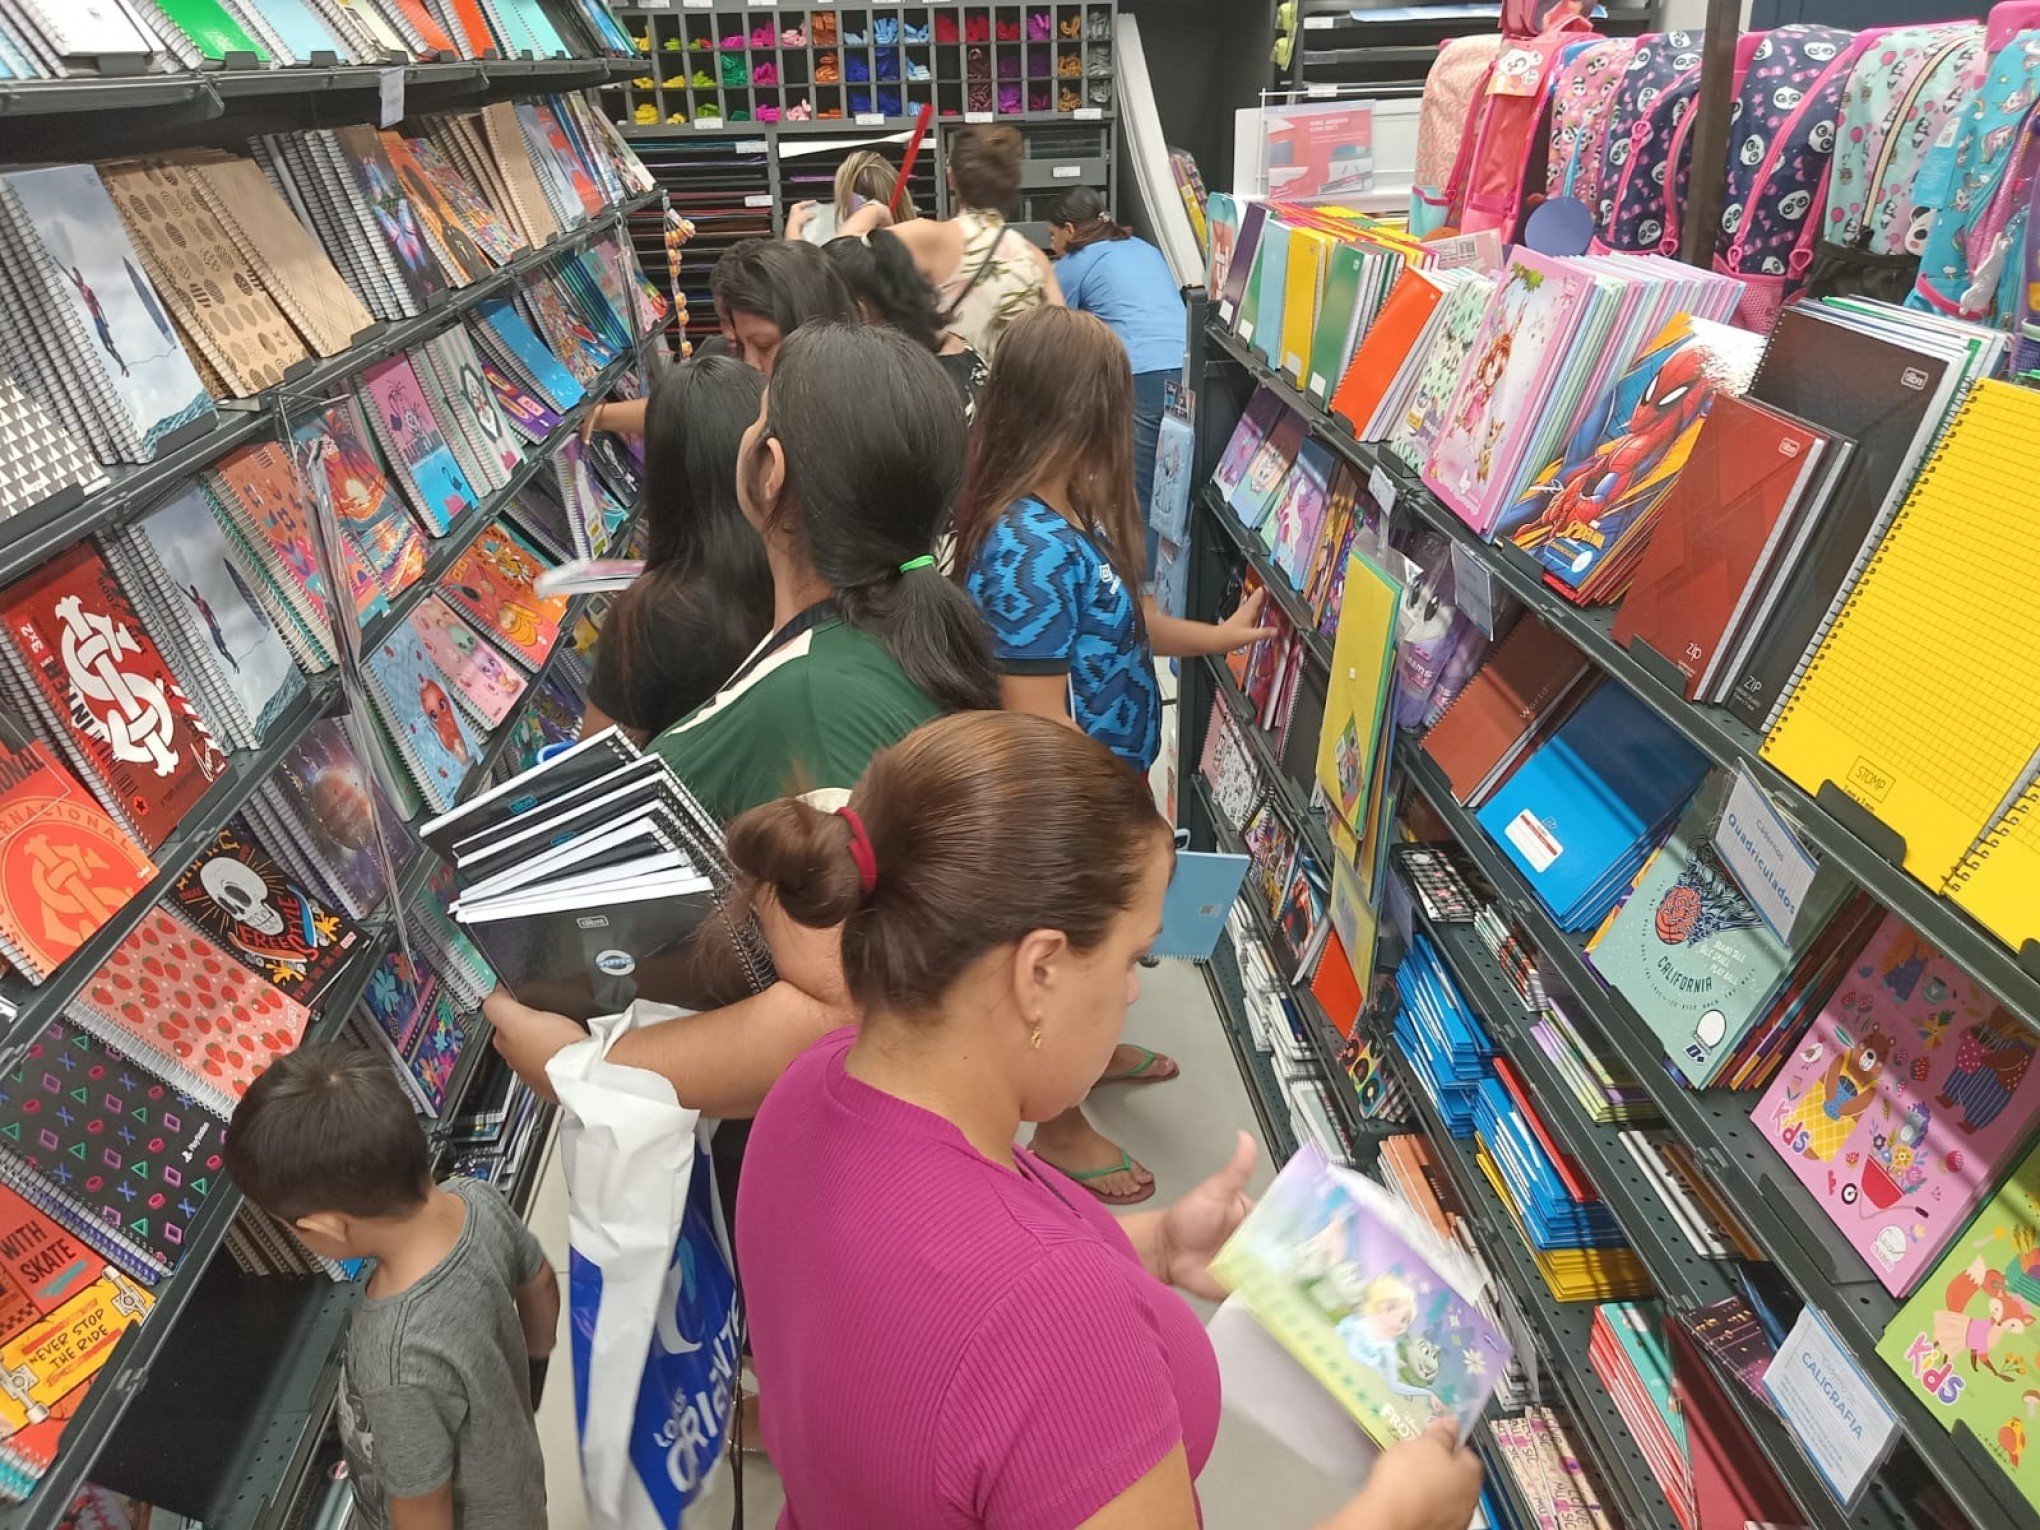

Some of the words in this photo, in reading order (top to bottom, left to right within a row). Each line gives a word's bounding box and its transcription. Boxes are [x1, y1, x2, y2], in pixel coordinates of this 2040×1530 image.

[1855, 766, 1886, 790] STOMP
[1728, 812, 1796, 915] Quadriculados
[1657, 956, 1713, 992] CALIFORNIA
[1771, 1101, 1811, 1153] Kids
[0, 1220, 47, 1261] WITH
[20, 1238, 77, 1284] SKATE
[28, 1332, 69, 1364] NEVER
[72, 1308, 104, 1336] STOP
[50, 1347, 76, 1369] THE
[77, 1325, 108, 1351] RIDE
[1905, 1332, 1966, 1405] Kids
[1802, 1352, 1863, 1439] CALIGRAFIA
